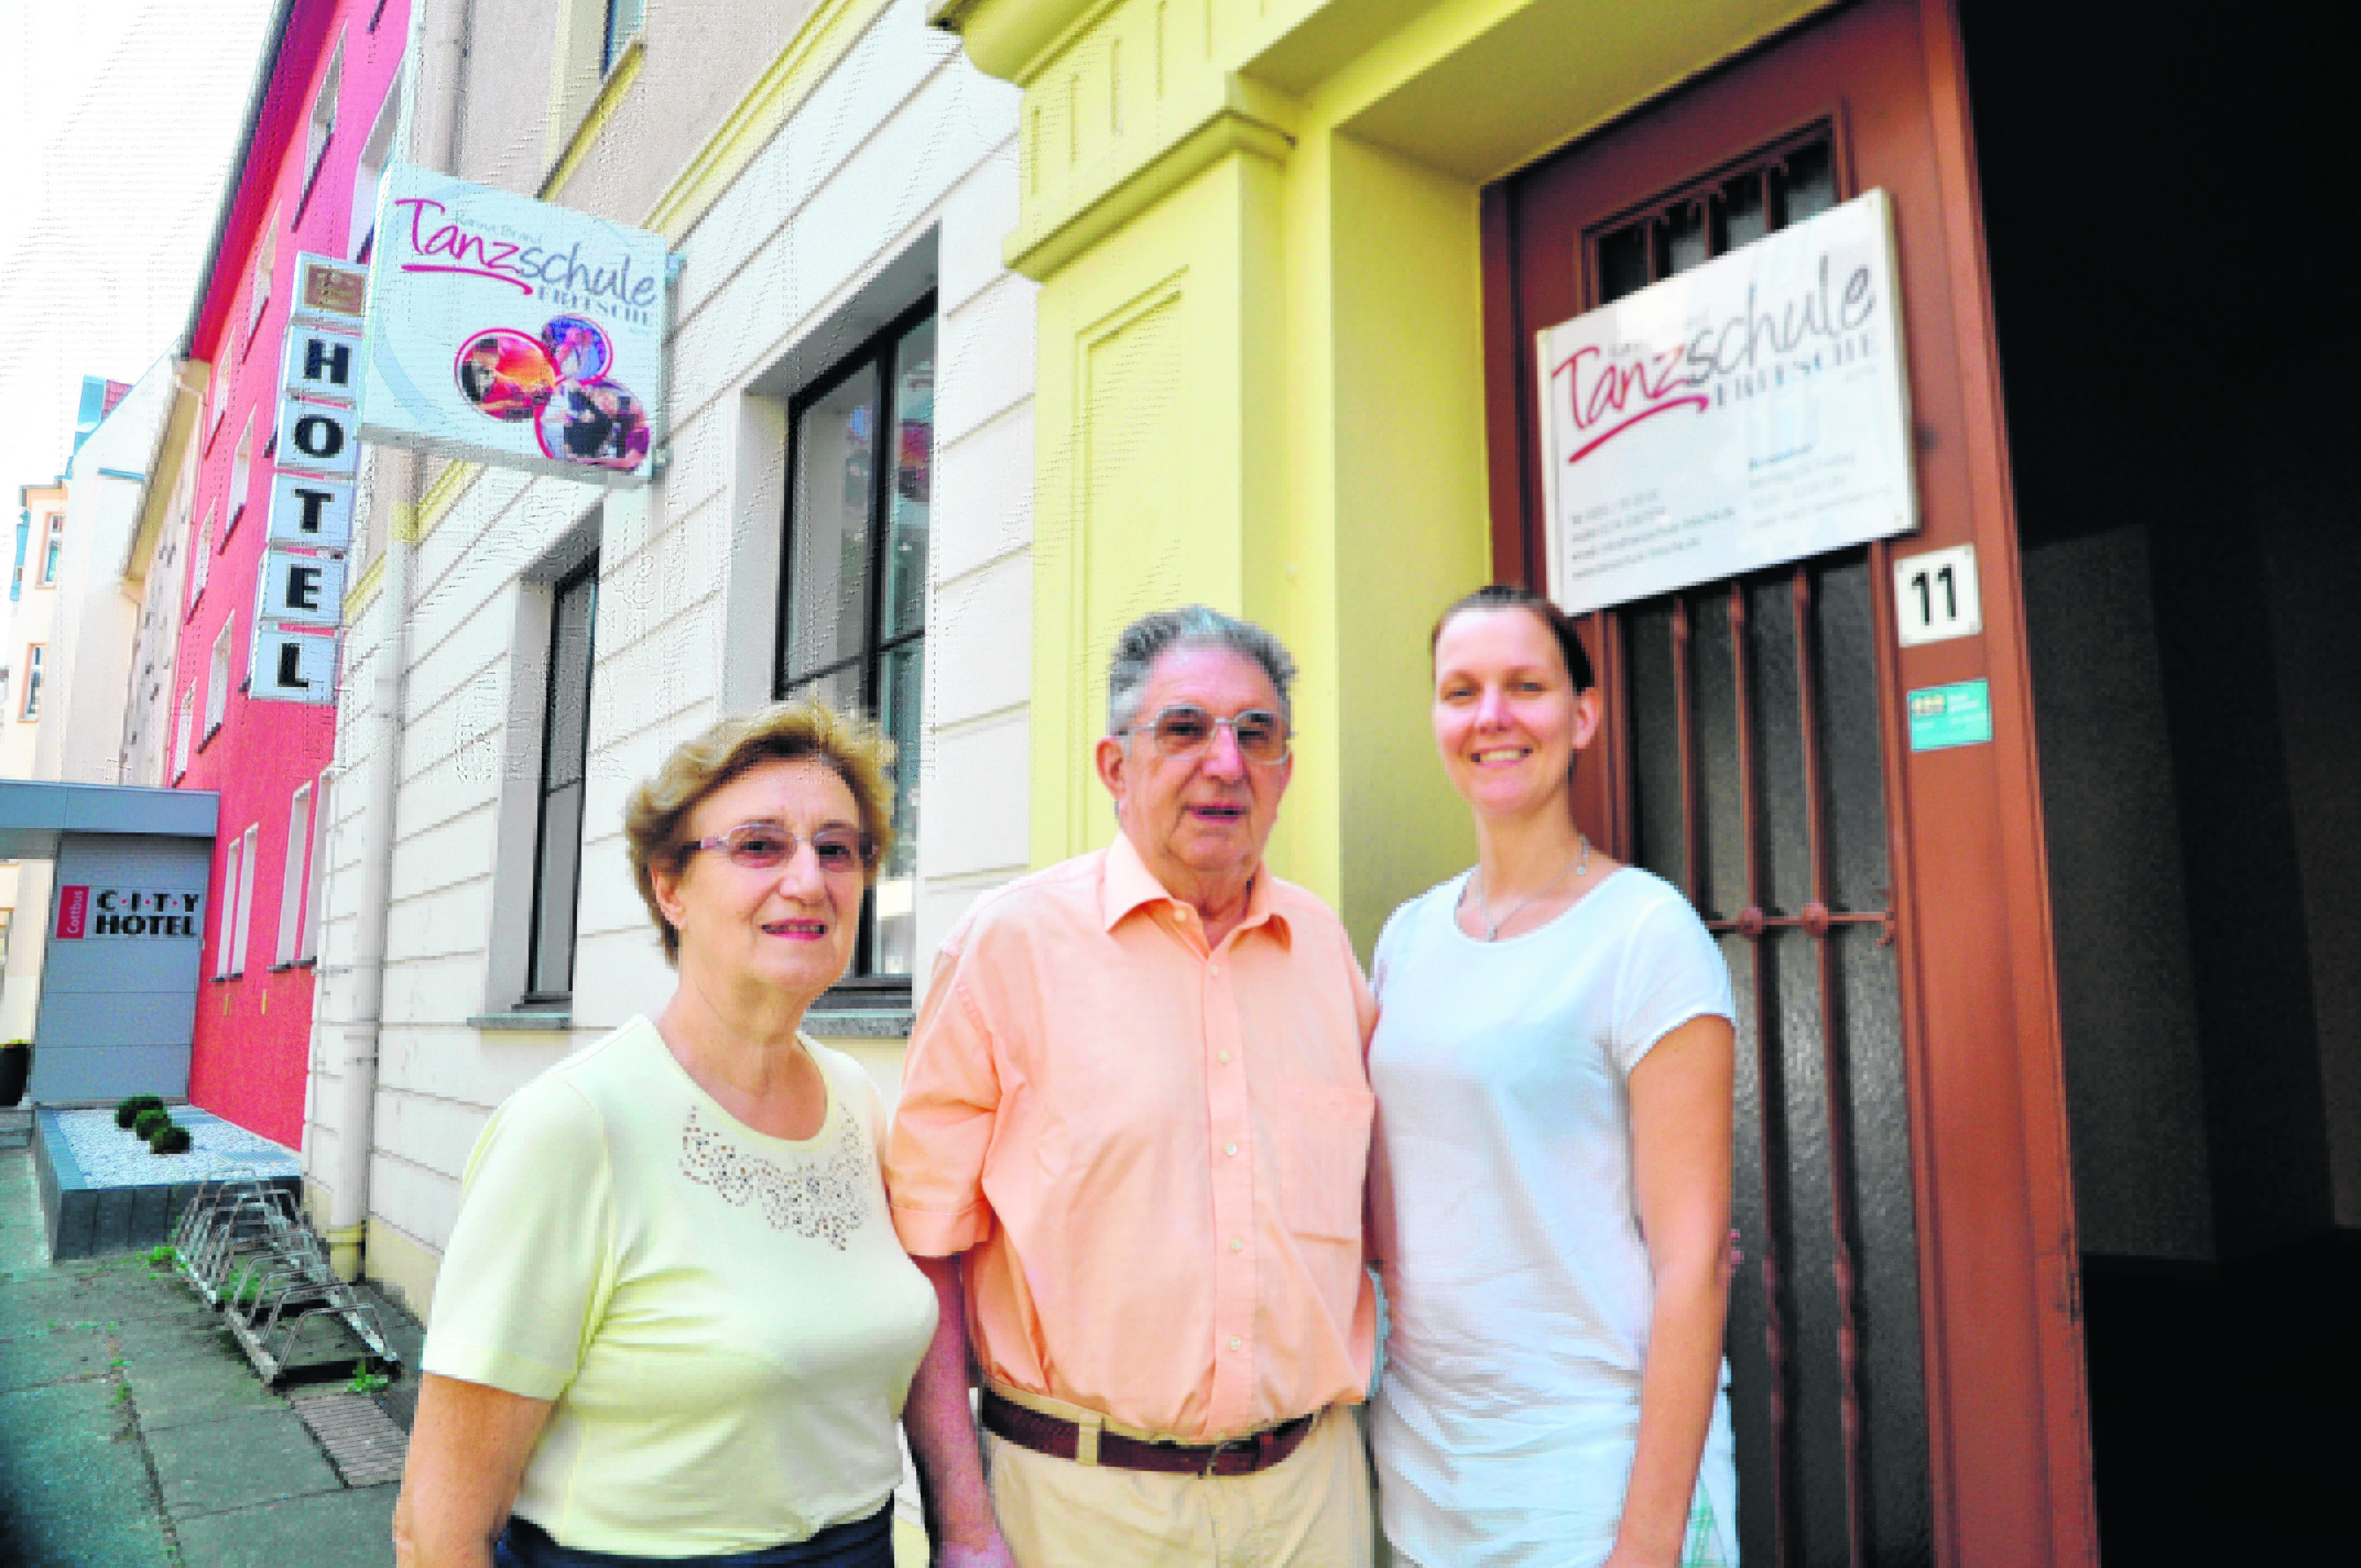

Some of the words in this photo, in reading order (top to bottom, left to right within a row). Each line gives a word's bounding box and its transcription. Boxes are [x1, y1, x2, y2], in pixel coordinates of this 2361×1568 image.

[394, 198, 657, 307] Tanzschule
[1552, 255, 1876, 430] Tanzschule
[278, 339, 351, 688] HOTEL
[1910, 564, 1957, 625] 11
[67, 889, 83, 934] Cottbus
[96, 915, 197, 936] HOTEL
